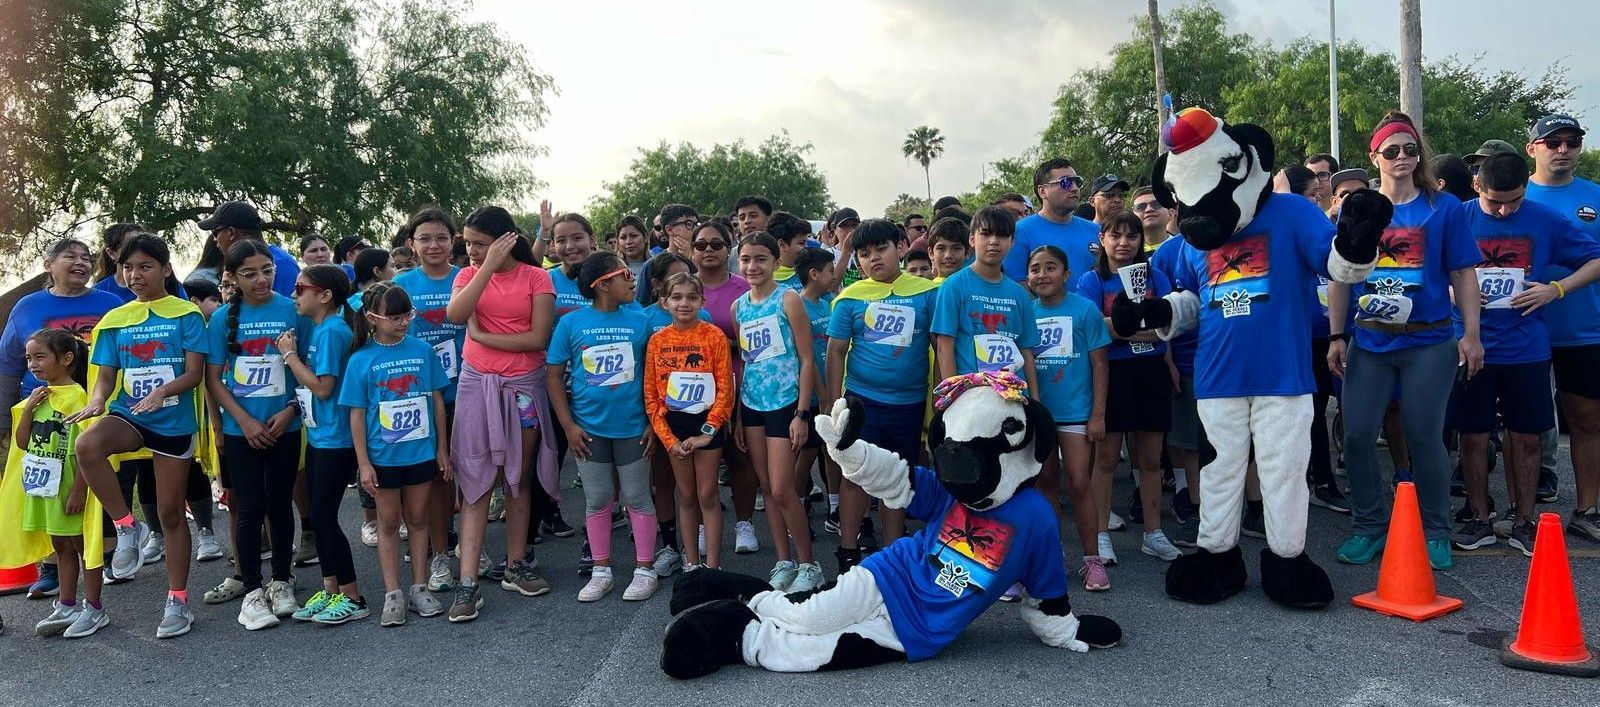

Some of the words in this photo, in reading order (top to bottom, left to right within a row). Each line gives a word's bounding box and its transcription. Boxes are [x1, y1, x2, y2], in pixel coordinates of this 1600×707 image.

[1481, 279, 1515, 296] 630
[1366, 298, 1400, 320] 672
[144, 324, 176, 332] ANYTHING
[874, 314, 906, 333] 826
[746, 328, 771, 350] 766
[442, 352, 451, 369] 6
[988, 346, 1014, 363] 732
[380, 361, 395, 369] GIVE
[595, 354, 624, 374] 762
[247, 368, 271, 384] 711
[678, 384, 705, 401] 710
[392, 409, 420, 430] 828
[24, 466, 50, 487] 650
